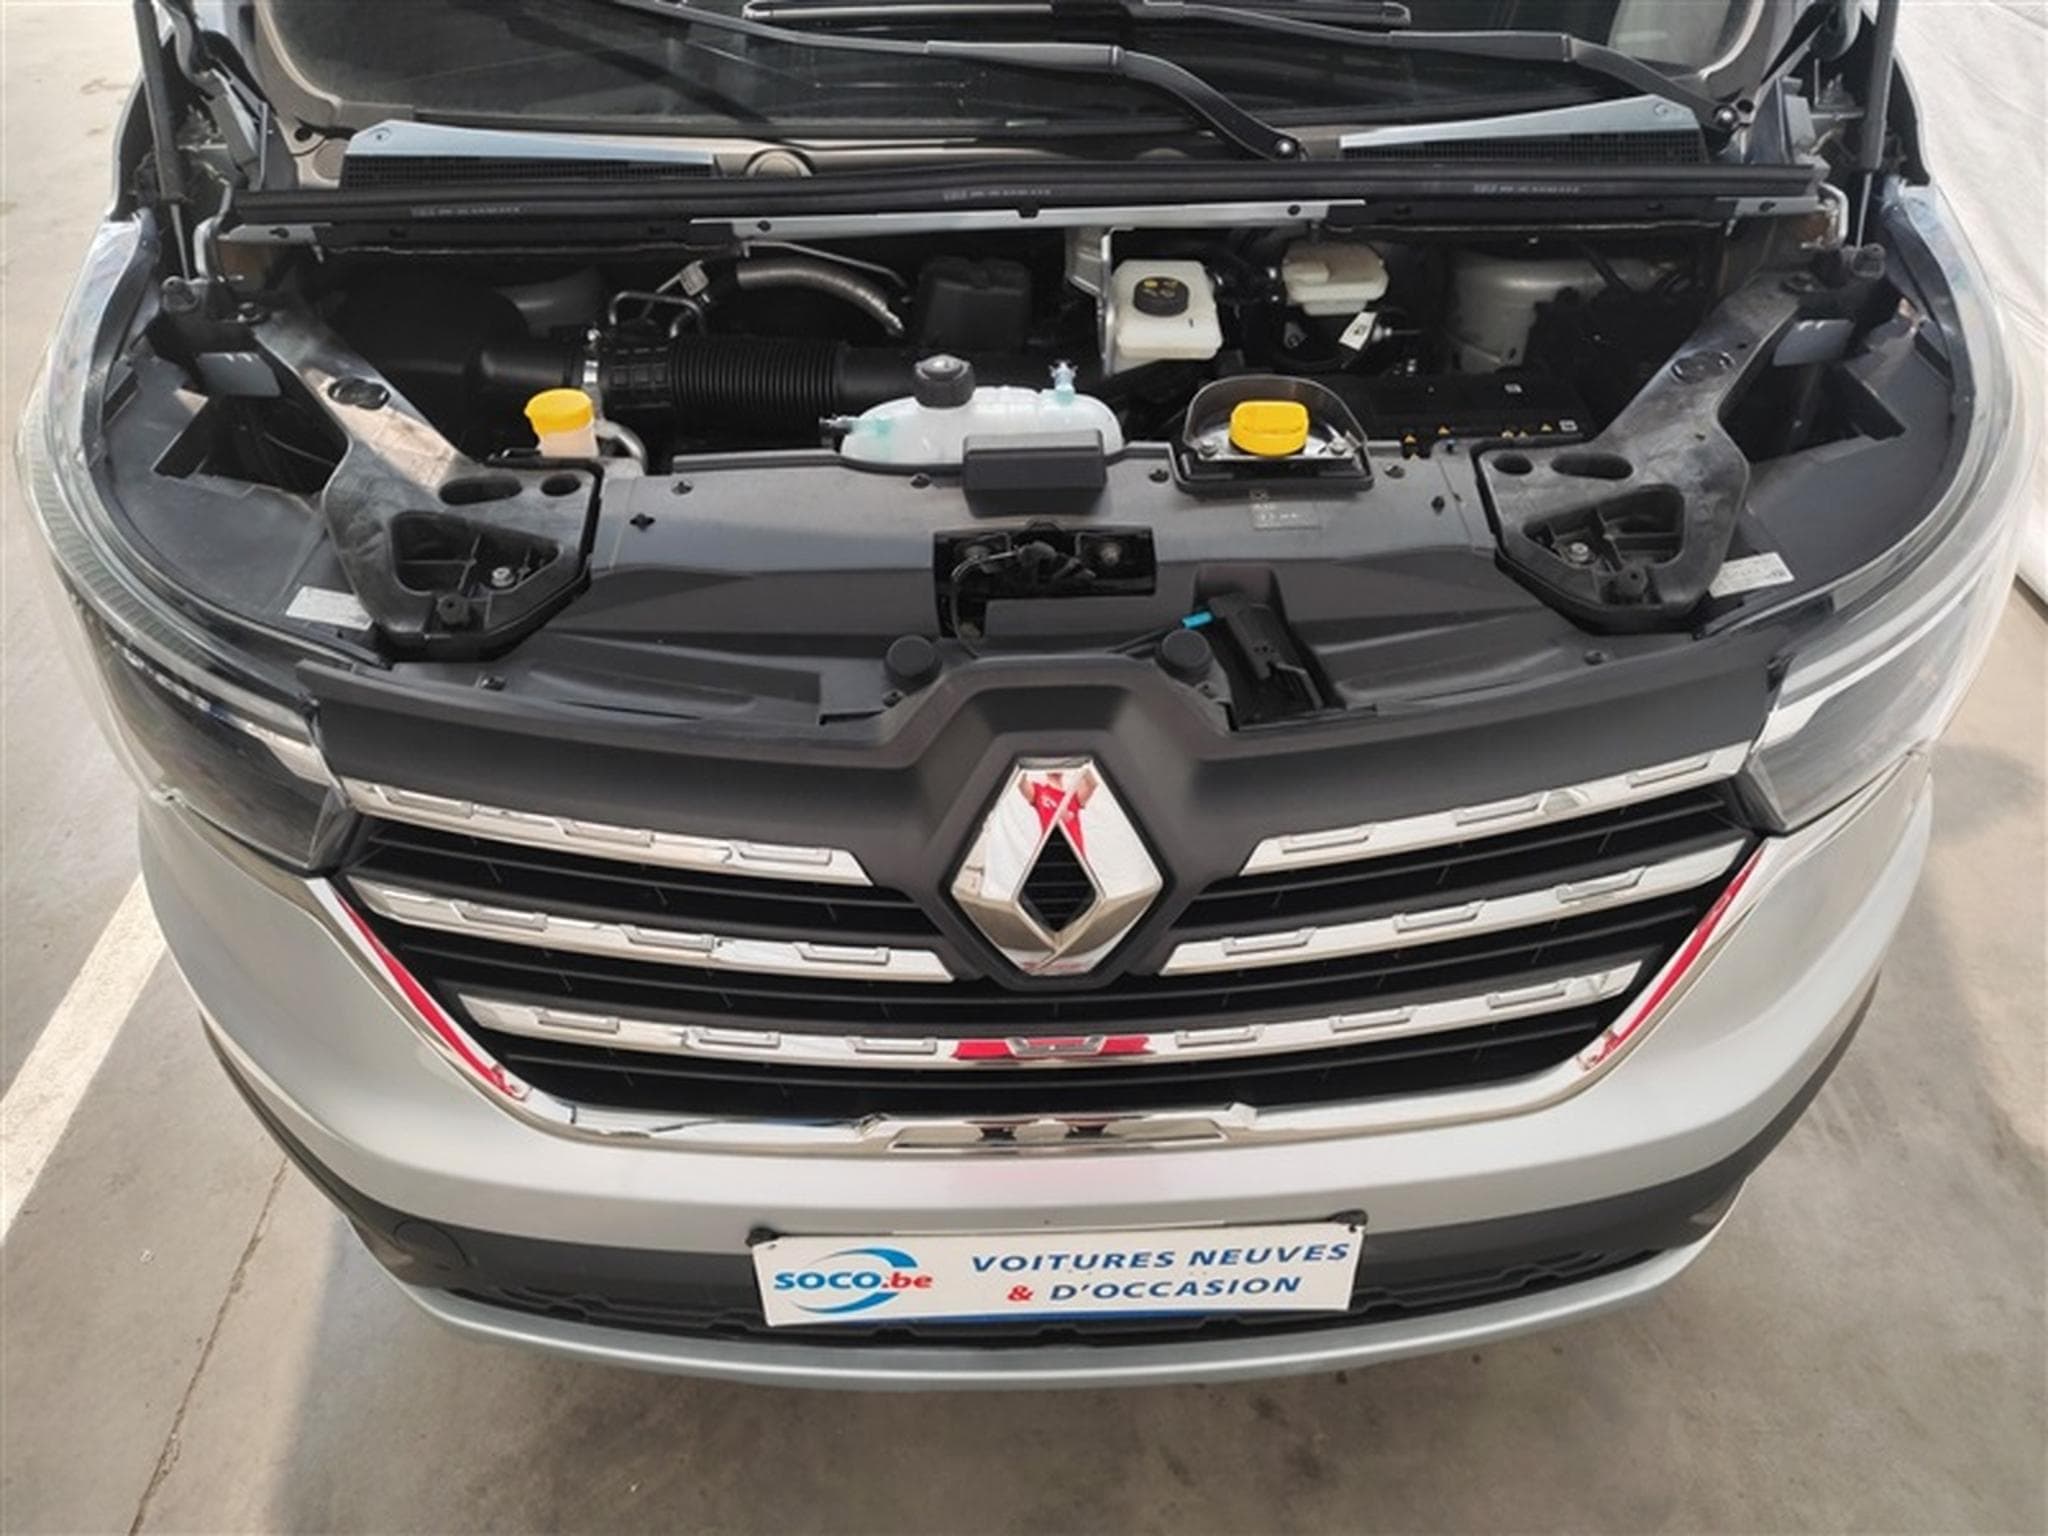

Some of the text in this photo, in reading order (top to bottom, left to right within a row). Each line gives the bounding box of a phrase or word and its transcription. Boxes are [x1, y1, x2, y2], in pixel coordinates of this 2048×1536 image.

[972, 1243, 1351, 1272] VOITURES NEUVES
[773, 1271, 933, 1290] SOCO.be
[1007, 1276, 1303, 1301] & D'OCCASION
